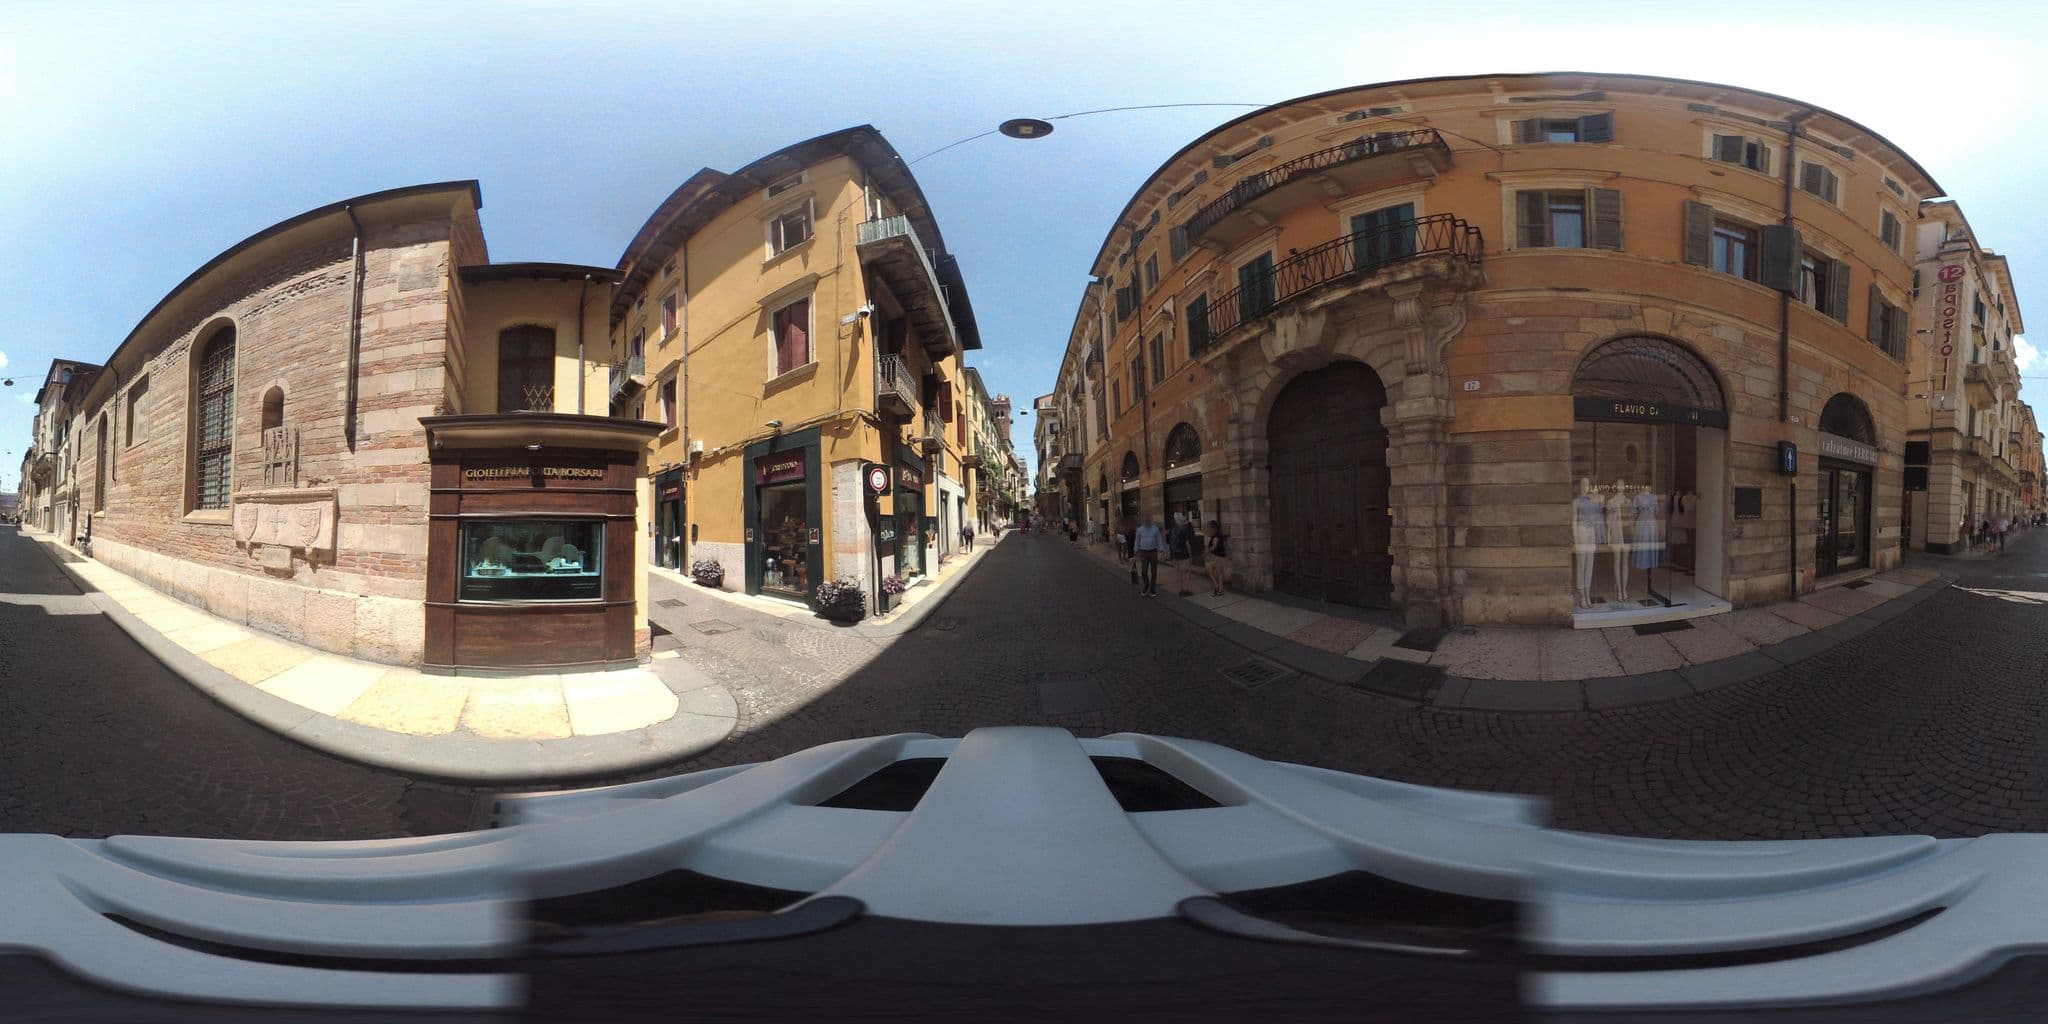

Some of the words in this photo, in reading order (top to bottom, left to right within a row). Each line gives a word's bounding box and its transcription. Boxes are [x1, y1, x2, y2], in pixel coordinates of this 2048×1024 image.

[1941, 267, 1961, 279] 12
[1614, 403, 1645, 415] FLAVIO
[560, 467, 603, 477] BORSARI
